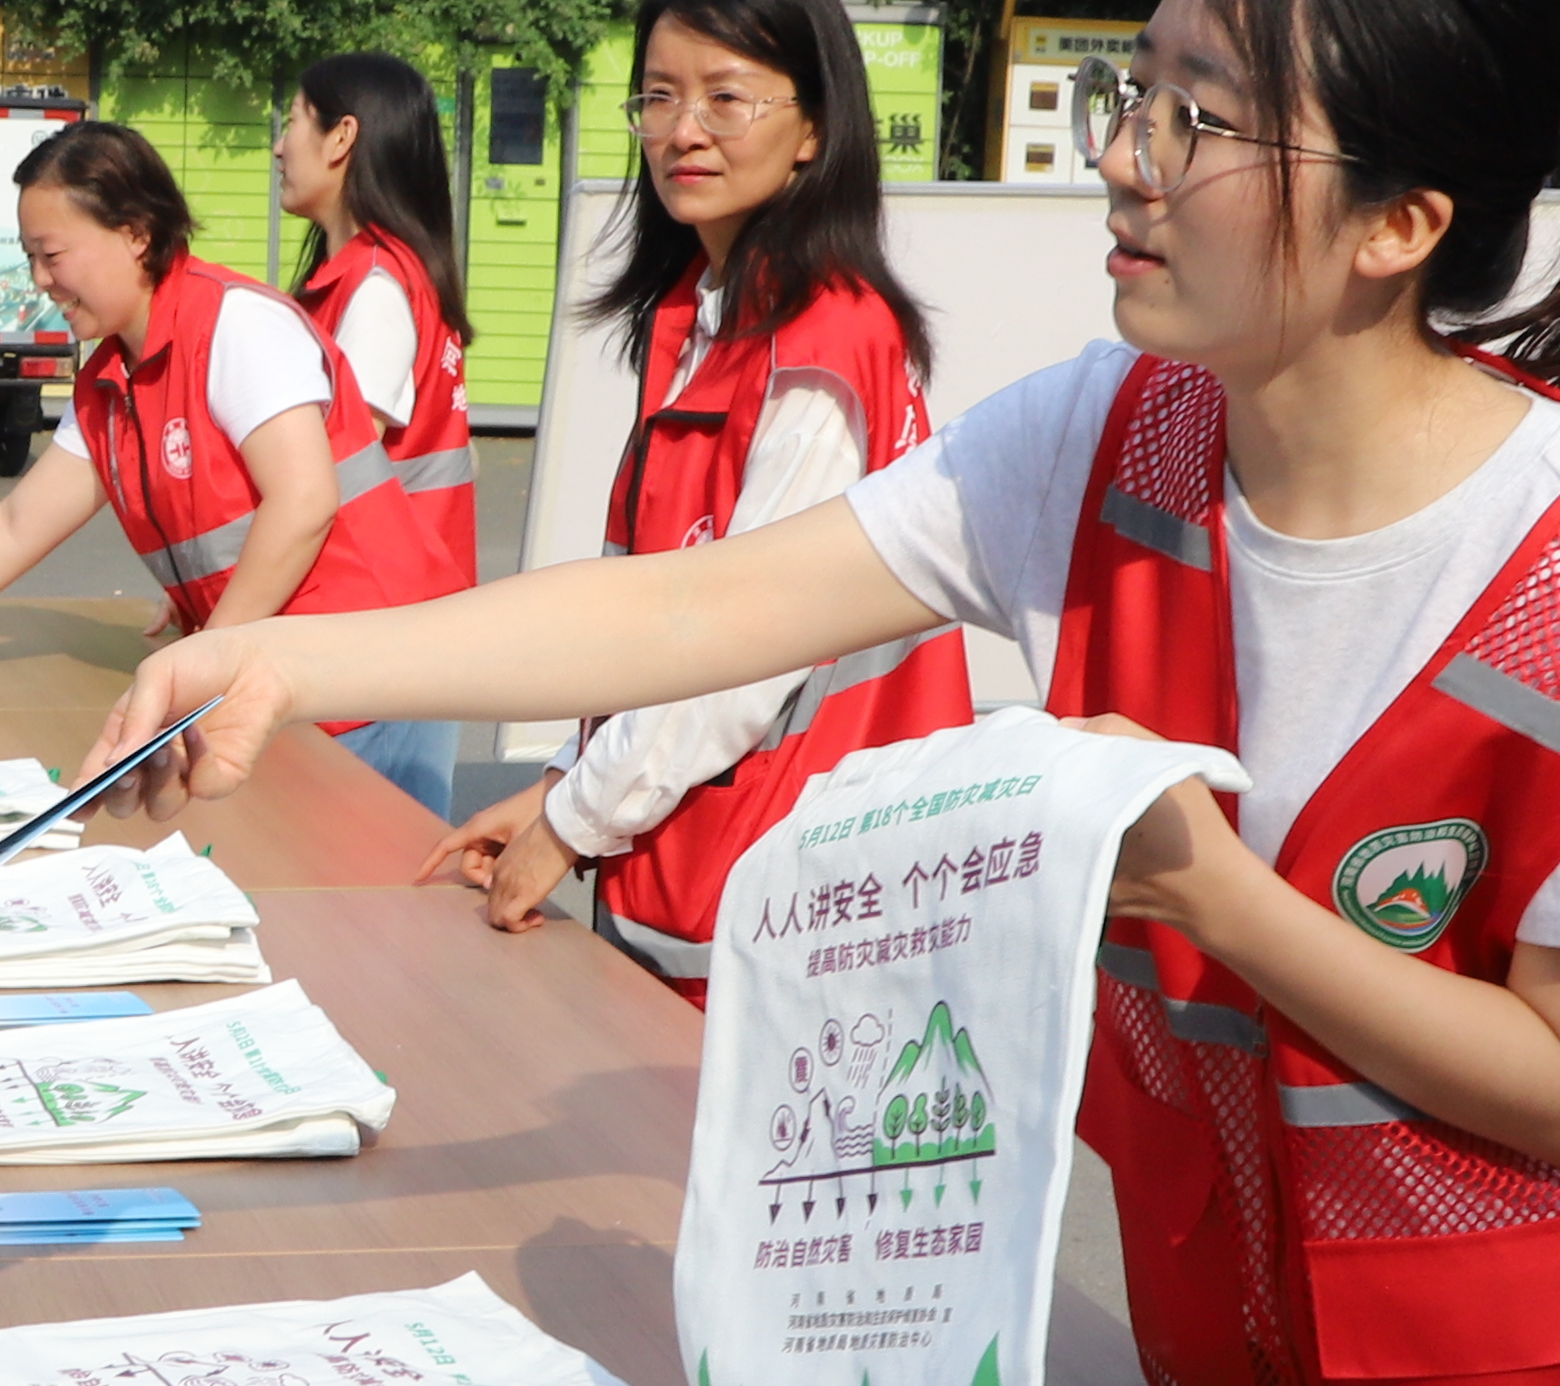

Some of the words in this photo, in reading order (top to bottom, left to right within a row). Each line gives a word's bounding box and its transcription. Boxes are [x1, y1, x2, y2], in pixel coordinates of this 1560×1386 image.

[859, 30, 904, 47] KUP
[874, 113, 925, 155] 巢
[798, 816, 857, 851] 5月12日
[856, 774, 1043, 836] 第18个全国防灾减灾日
[752, 871, 885, 944] 人人讲安全
[901, 829, 1044, 910] 个个会应急
[805, 912, 973, 979] 提高防灾减灾救灾能力
[753, 1233, 853, 1270] 防治自然灾害
[874, 1220, 985, 1262] 修复生态家园
